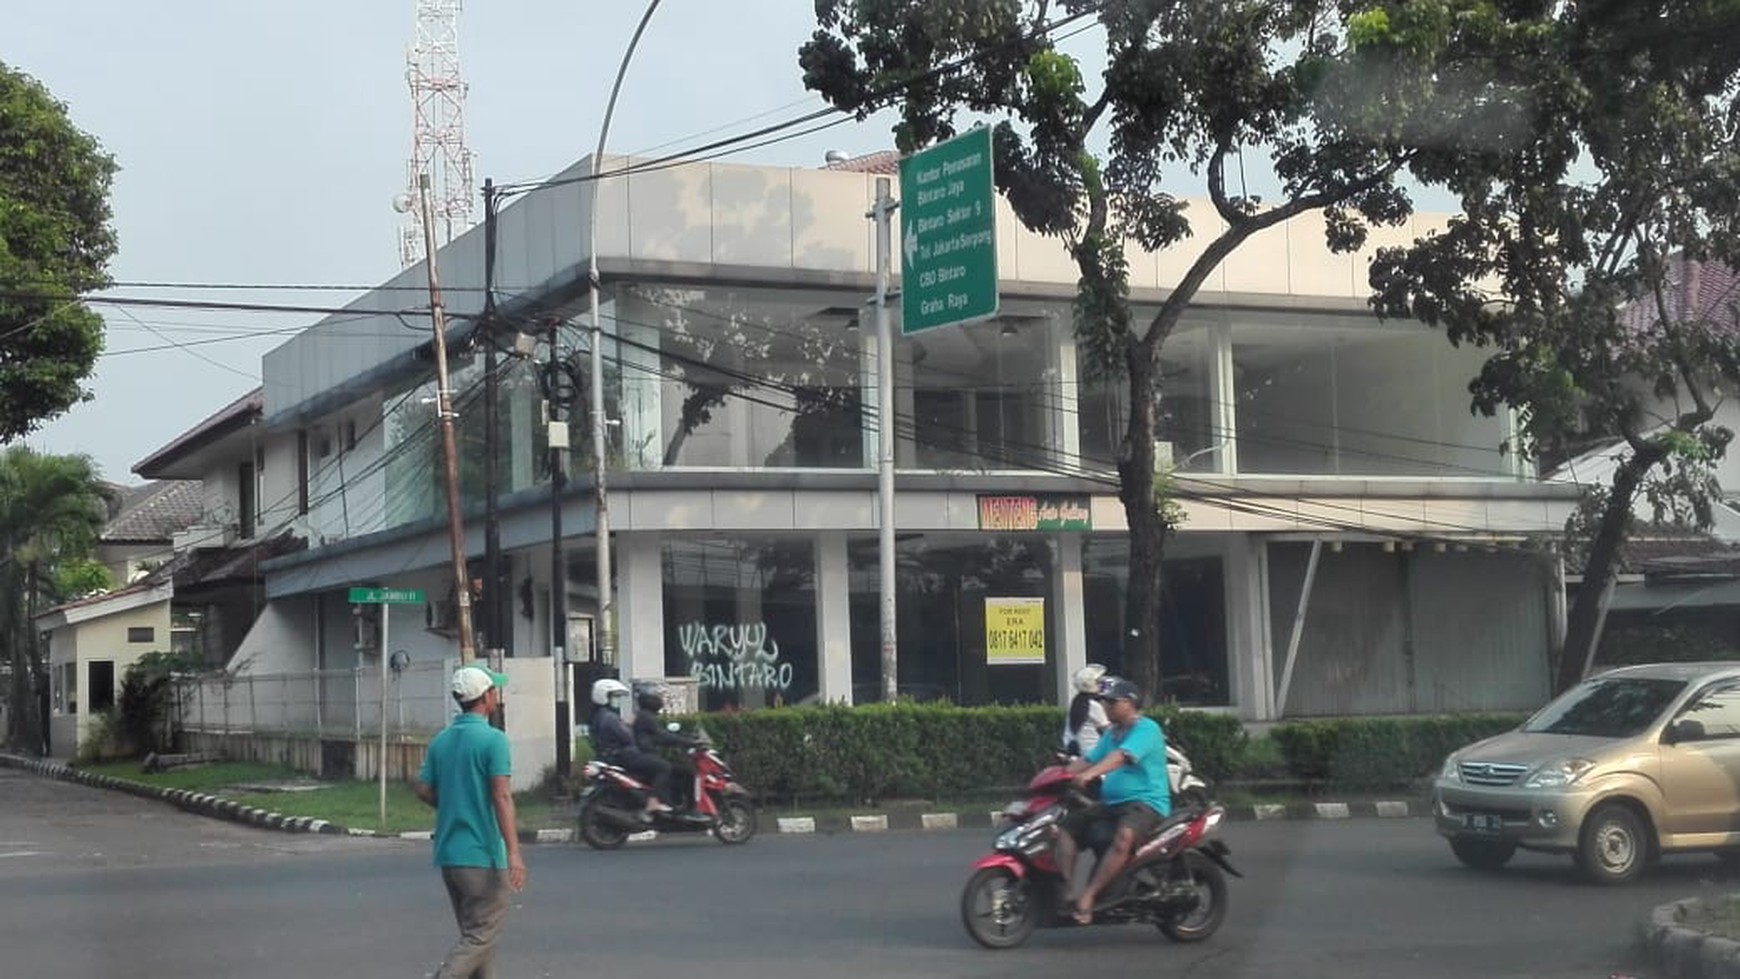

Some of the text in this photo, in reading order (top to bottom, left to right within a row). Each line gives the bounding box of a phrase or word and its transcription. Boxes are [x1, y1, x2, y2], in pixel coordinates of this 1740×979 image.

[916, 168, 940, 185] Kantor
[918, 180, 965, 206] Bintaro Jaya
[918, 215, 945, 233] Bintaro
[974, 200, 981, 216] 9
[938, 266, 966, 282] Bintaro
[921, 293, 968, 314] Graha Raya
[989, 629, 1043, 650] 0817 6417 042
[690, 661, 793, 690] BINTARO
